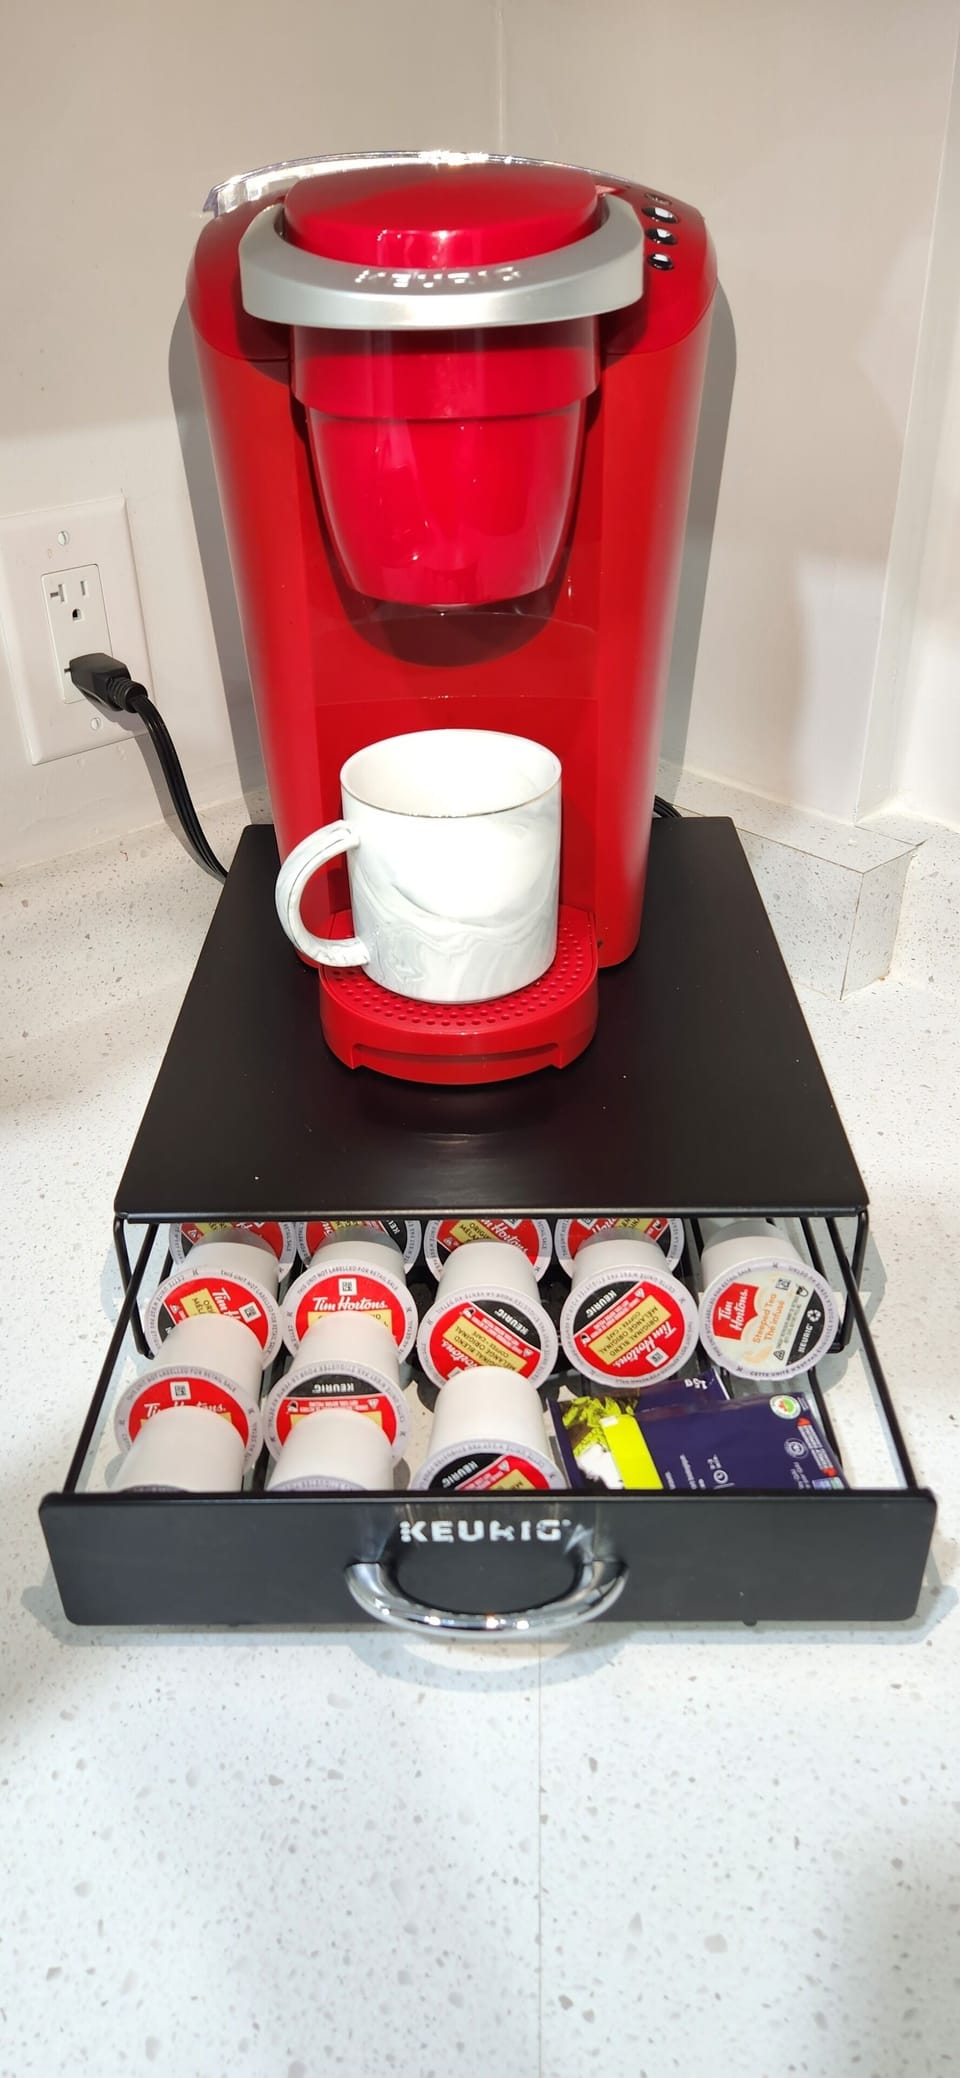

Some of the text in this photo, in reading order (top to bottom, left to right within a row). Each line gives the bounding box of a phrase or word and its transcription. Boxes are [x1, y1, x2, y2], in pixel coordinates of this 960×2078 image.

[212, 1288, 231, 1311] Tim
[312, 1294, 388, 1311] Tim Hortons
[586, 1290, 617, 1316] KEURIG
[718, 1300, 734, 1320] Tim
[729, 1289, 748, 1331] Hortons
[497, 1309, 529, 1335] KEURIG
[631, 1316, 659, 1340] ORIGINAL
[652, 1321, 677, 1339] Tim
[454, 1335, 474, 1353] BLEND
[456, 1326, 485, 1350] ORIGINAL
[599, 1331, 628, 1353] ORIGINAL
[610, 1340, 630, 1356] BLEND
[614, 1336, 655, 1368] Hortons
[314, 1383, 354, 1393] KEURIG
[442, 1461, 478, 1489] KEURIG
[400, 1519, 562, 1543] KEURIG
